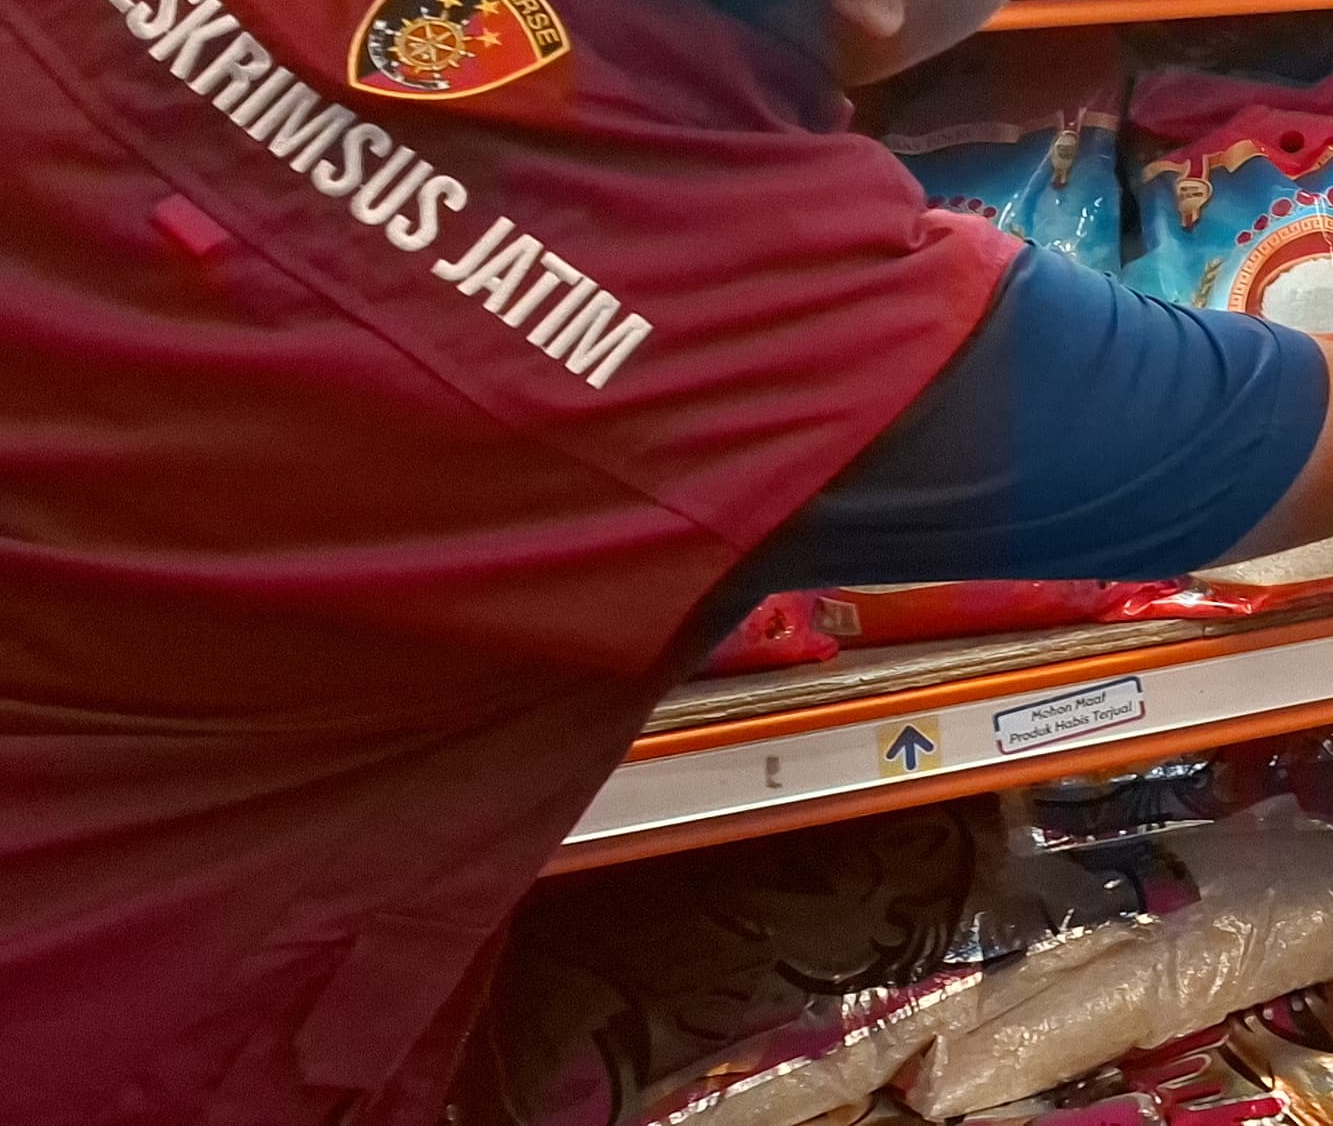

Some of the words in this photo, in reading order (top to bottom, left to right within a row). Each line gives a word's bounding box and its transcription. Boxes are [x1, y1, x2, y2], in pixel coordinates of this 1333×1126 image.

[434, 216, 654, 391] JATIM
[1009, 725, 1053, 745] Produk
[1055, 713, 1090, 732] Habis
[1092, 700, 1134, 723] Terjual
[1031, 701, 1073, 722] Mohon
[1075, 691, 1107, 710] Maaf
